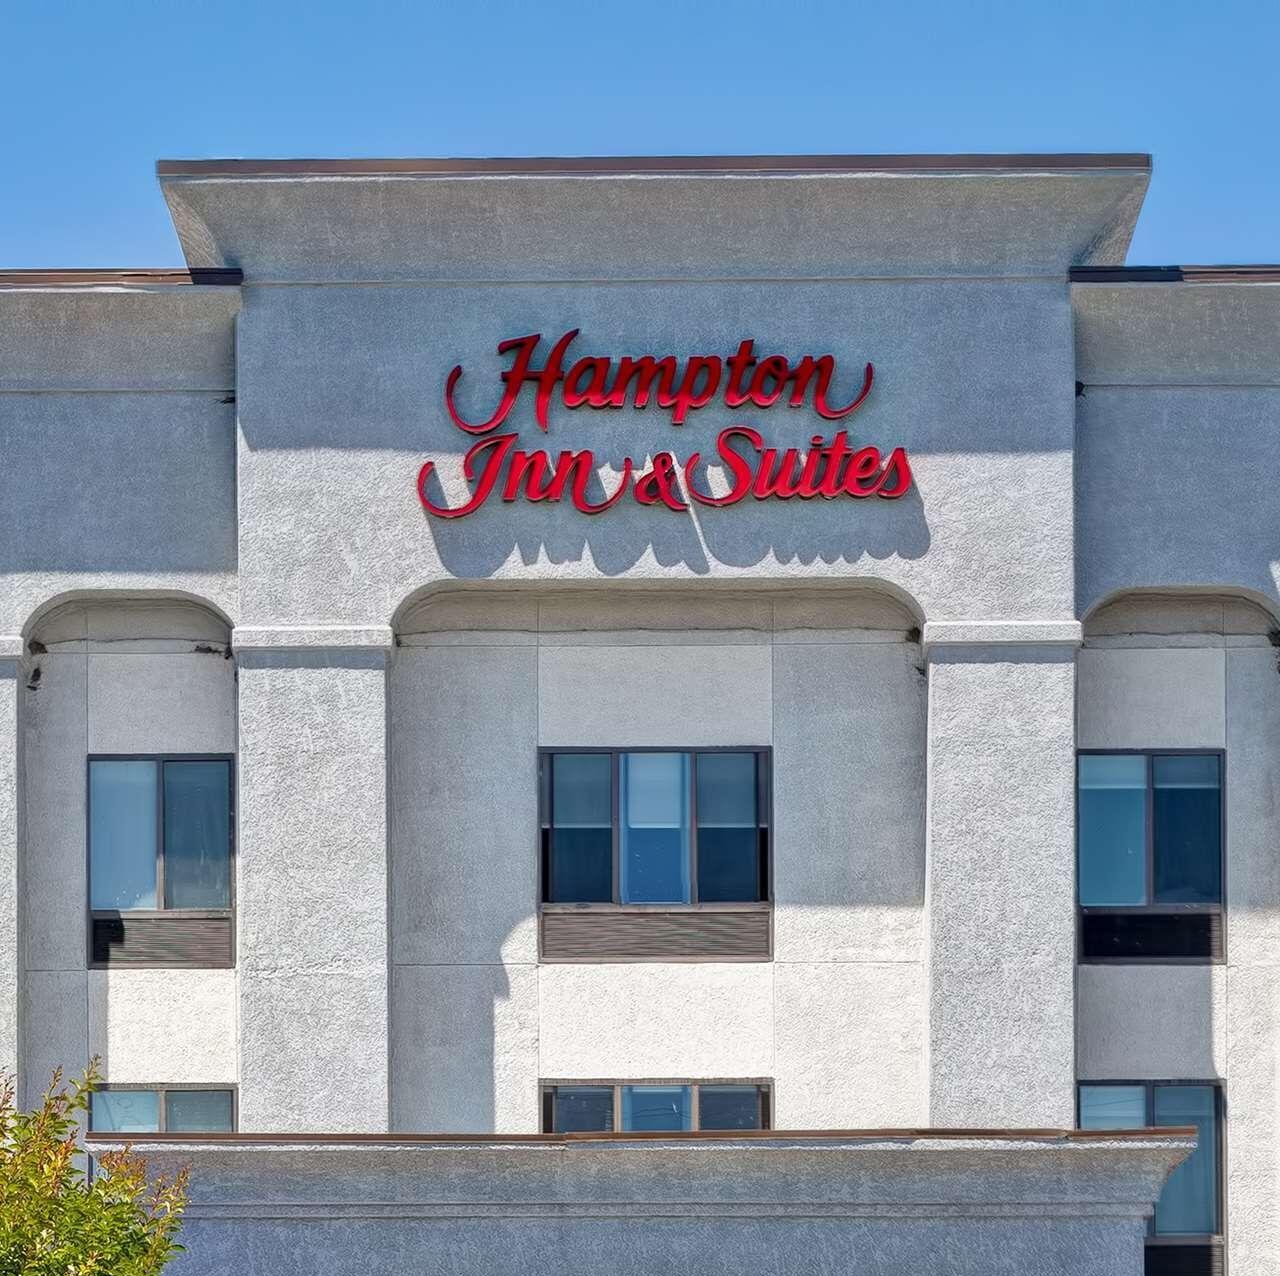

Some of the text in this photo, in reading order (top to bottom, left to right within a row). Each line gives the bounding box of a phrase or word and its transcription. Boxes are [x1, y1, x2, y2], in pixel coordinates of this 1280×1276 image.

[446, 328, 873, 434] Hampton
[419, 426, 912, 518] Inn & Suites
